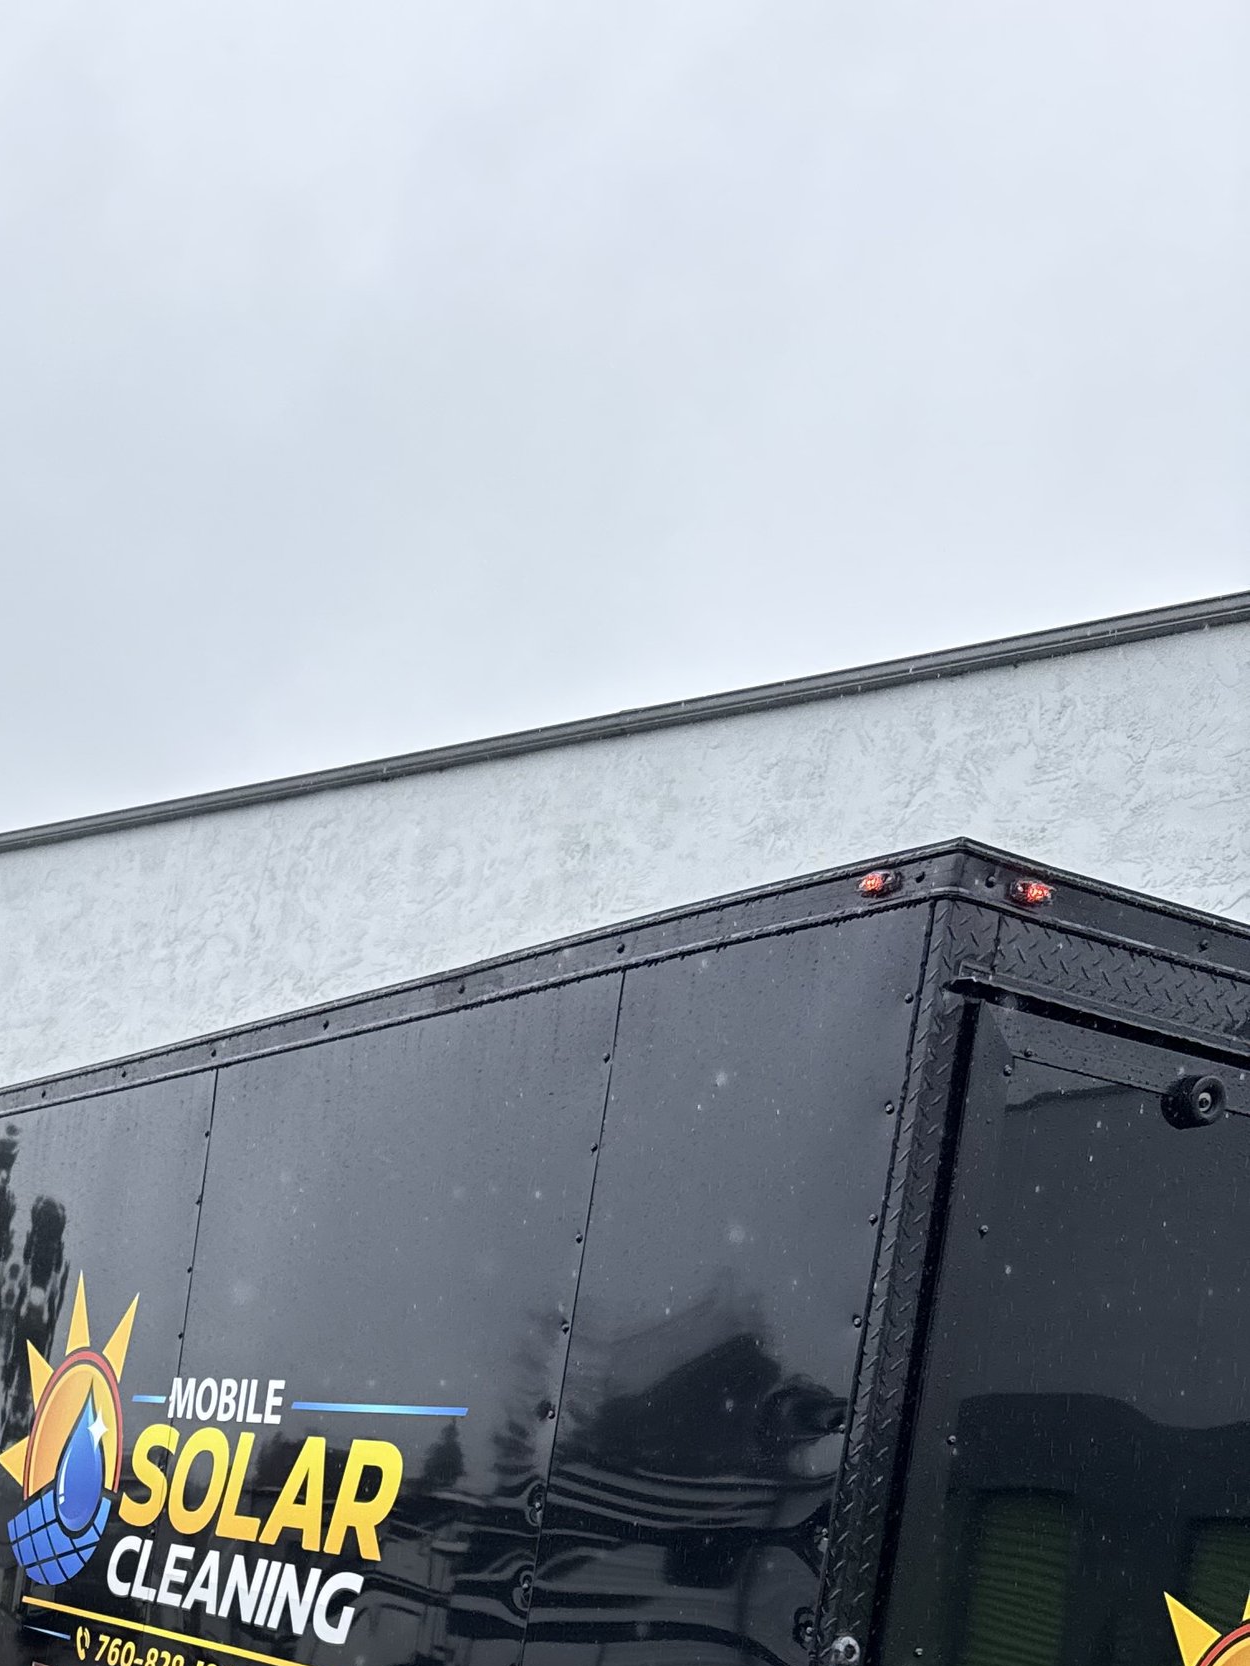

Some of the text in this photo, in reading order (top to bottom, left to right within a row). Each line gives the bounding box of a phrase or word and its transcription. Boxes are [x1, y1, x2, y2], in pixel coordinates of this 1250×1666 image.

[167, 1377, 286, 1424] MOBILE
[118, 1423, 403, 1561] SOLAR
[106, 1535, 364, 1644] CLEANING
